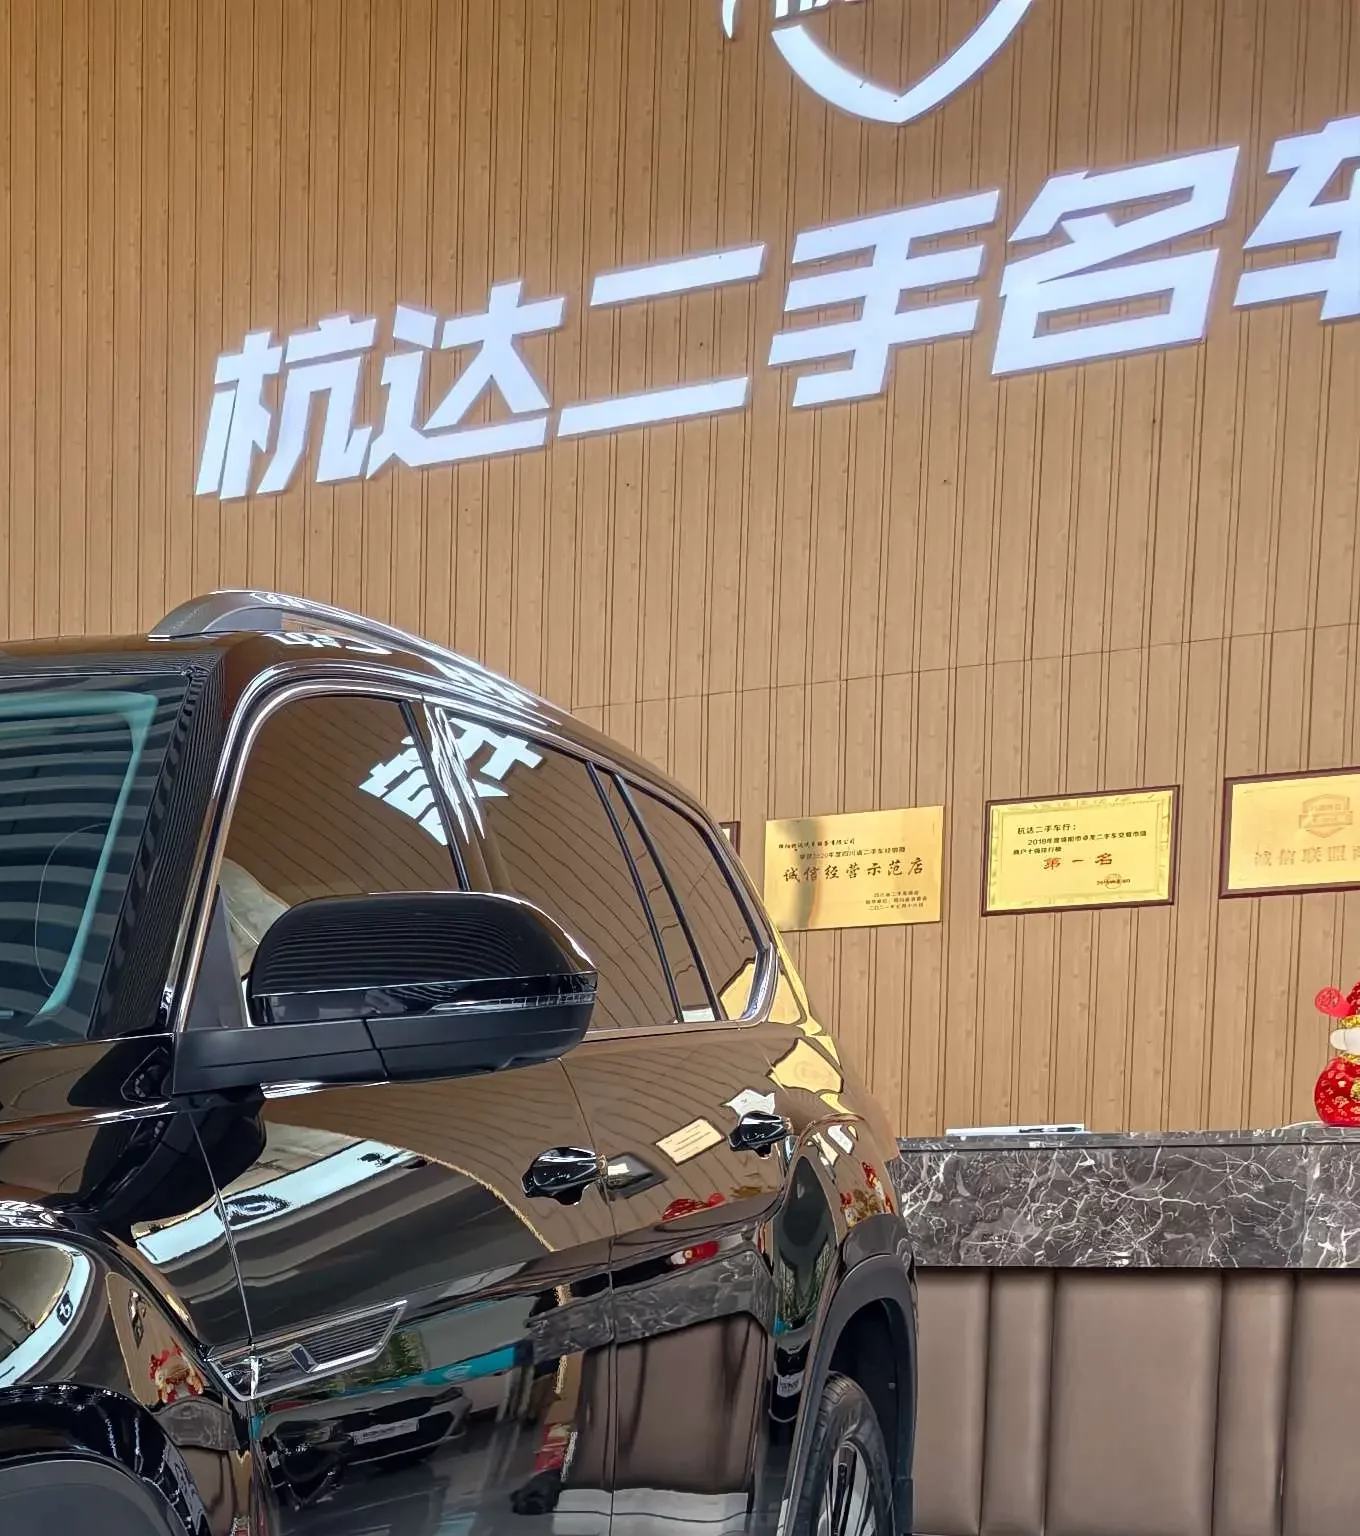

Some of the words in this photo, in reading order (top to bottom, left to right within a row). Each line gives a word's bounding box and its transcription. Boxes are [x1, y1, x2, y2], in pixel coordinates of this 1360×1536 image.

[783, 856, 925, 883] 诚信经营示范店
